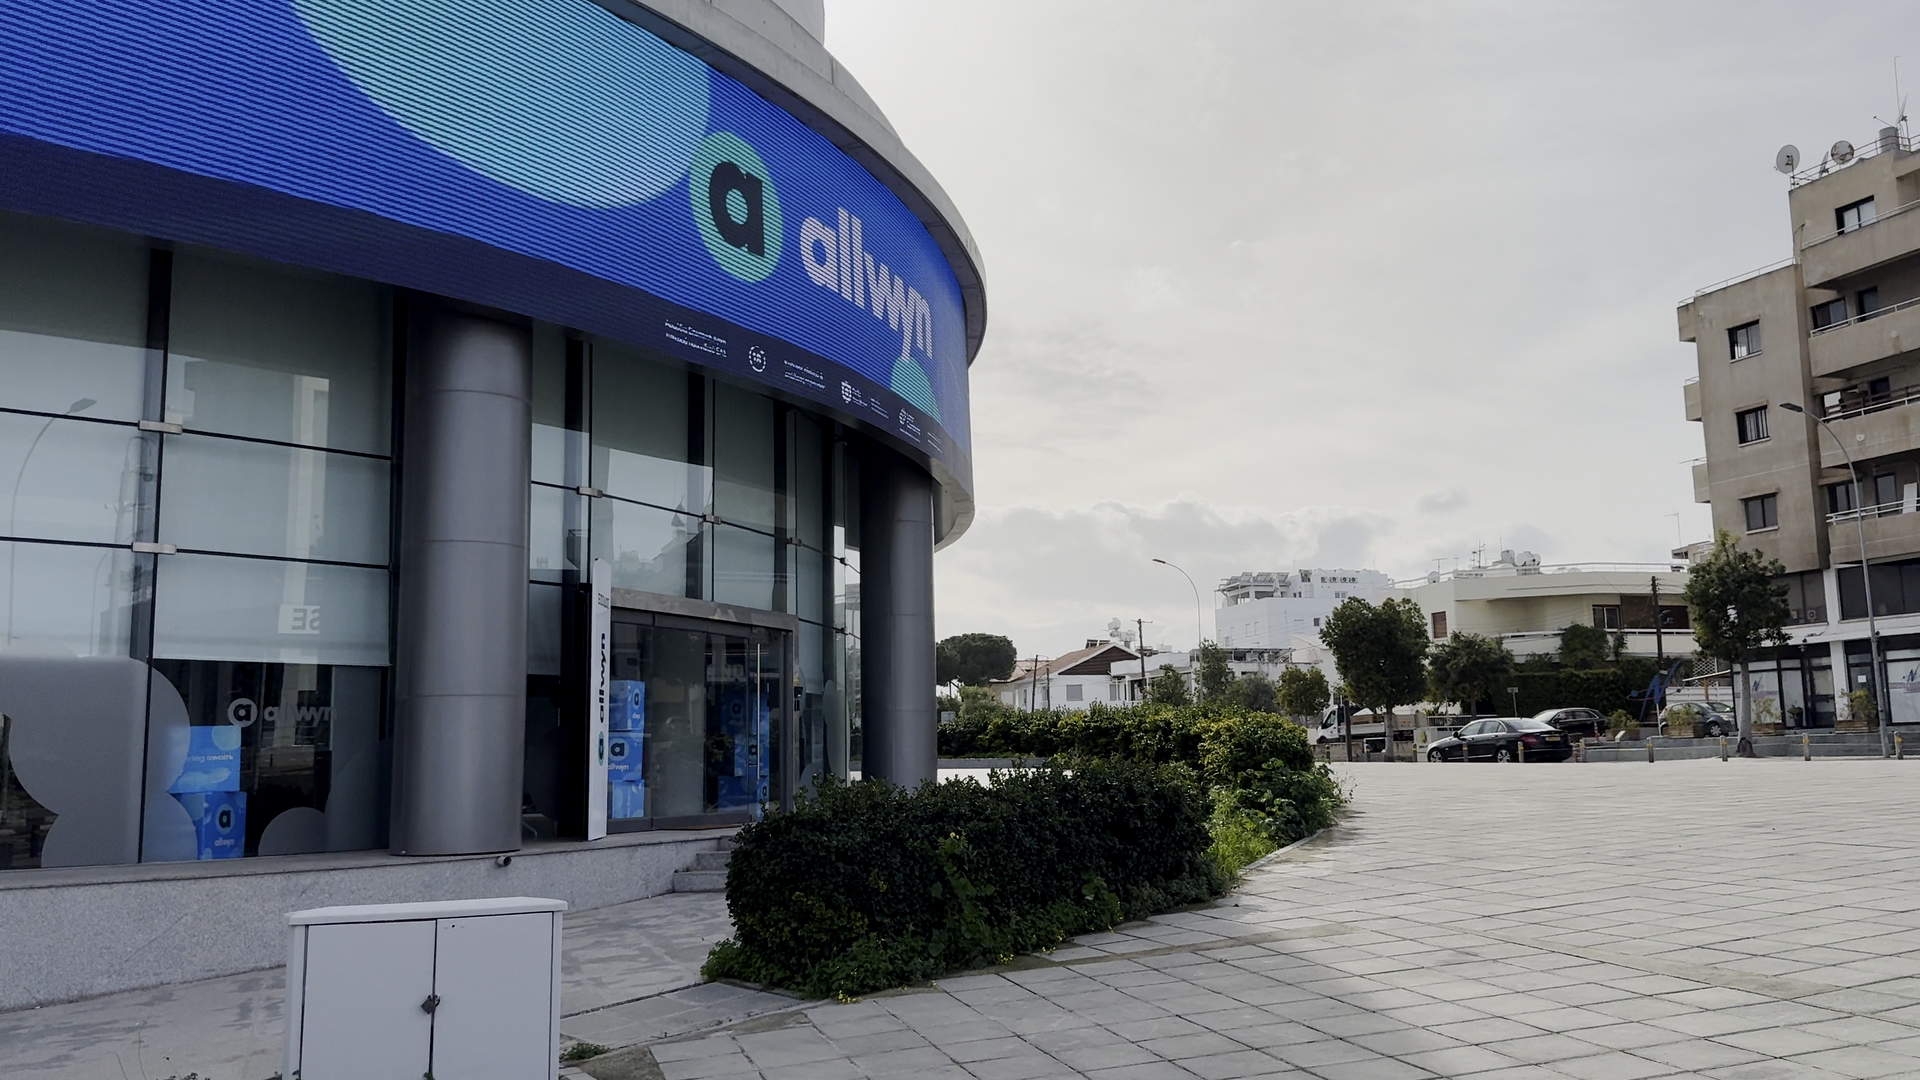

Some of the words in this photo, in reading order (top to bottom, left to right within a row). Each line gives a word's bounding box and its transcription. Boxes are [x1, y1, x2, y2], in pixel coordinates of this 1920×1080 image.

[709, 161, 765, 258] a
[800, 206, 932, 361] allwyn
[598, 632, 606, 724] allwyn
[233, 704, 252, 722] a
[611, 742, 625, 757] a
[218, 809, 231, 828] a
